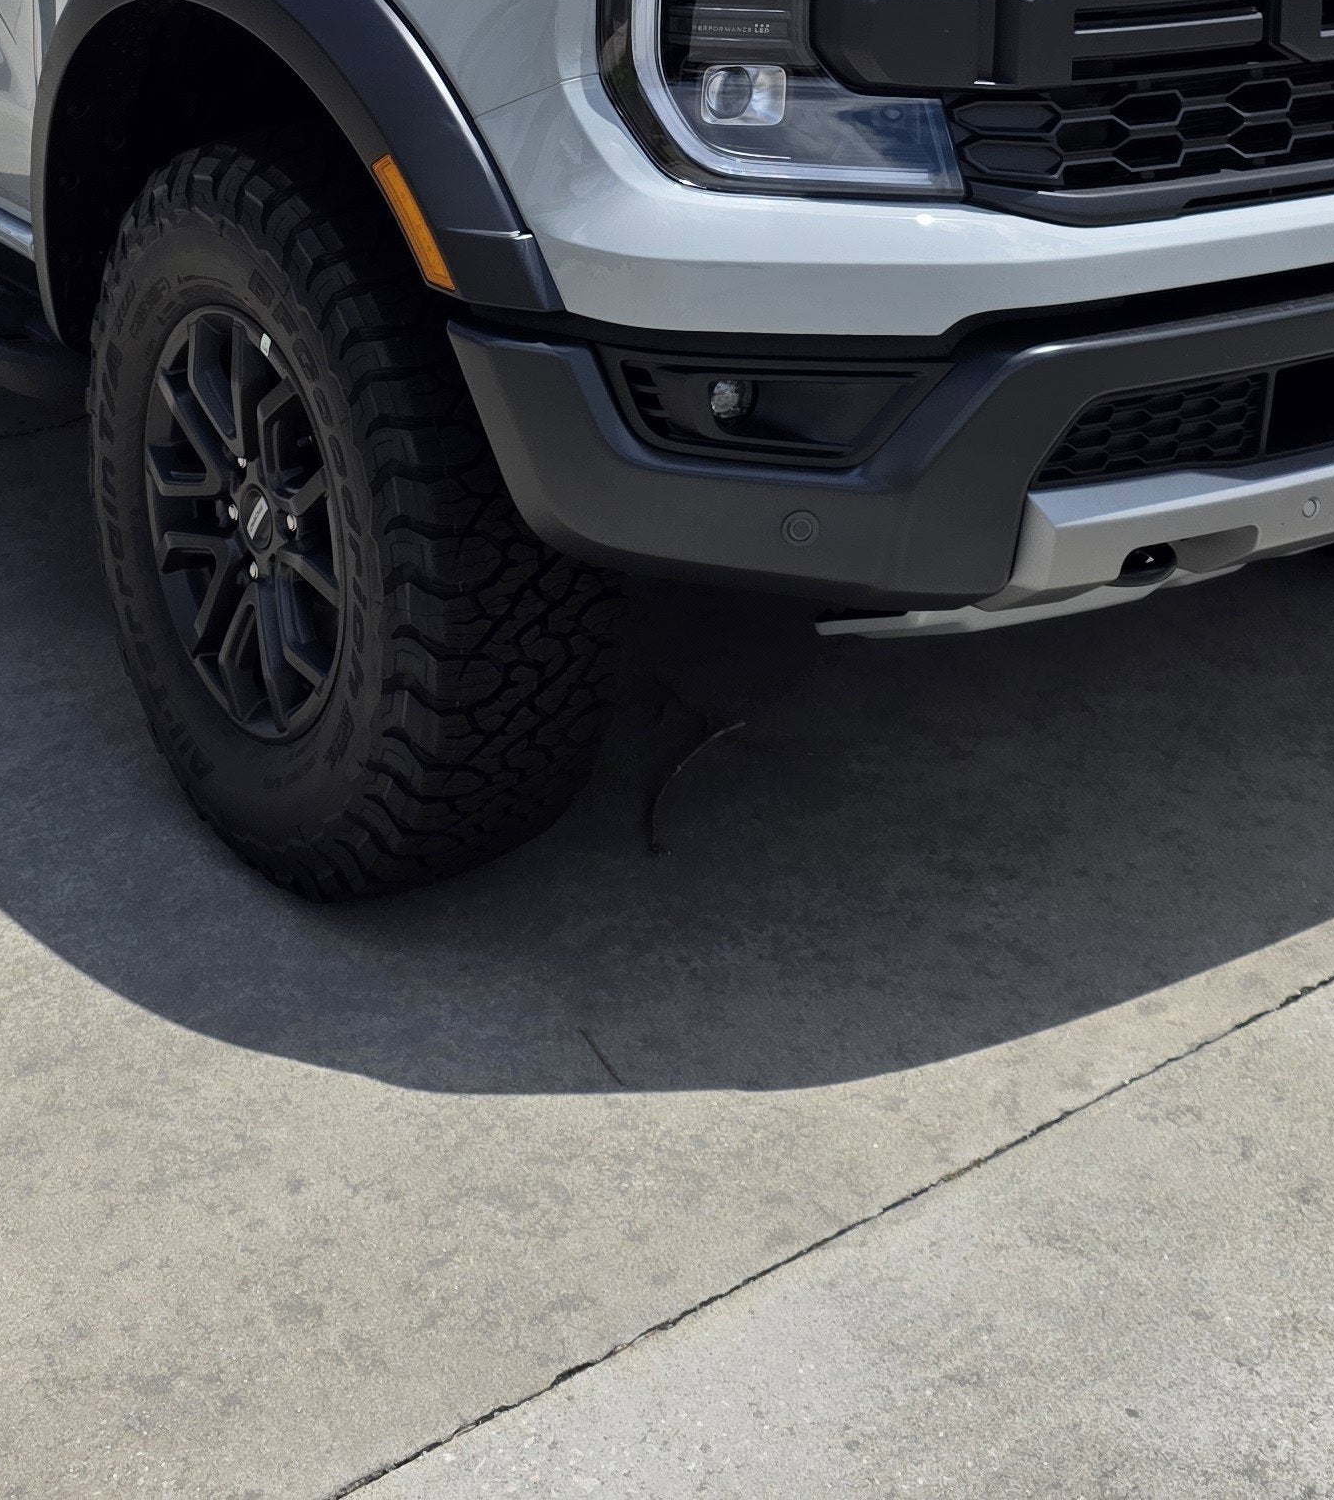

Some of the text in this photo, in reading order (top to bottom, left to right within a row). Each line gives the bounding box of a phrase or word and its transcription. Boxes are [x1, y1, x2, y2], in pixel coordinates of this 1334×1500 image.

[691, 24, 770, 33] PERFORMANCE LED
[247, 266, 368, 706] BFGoodrich
